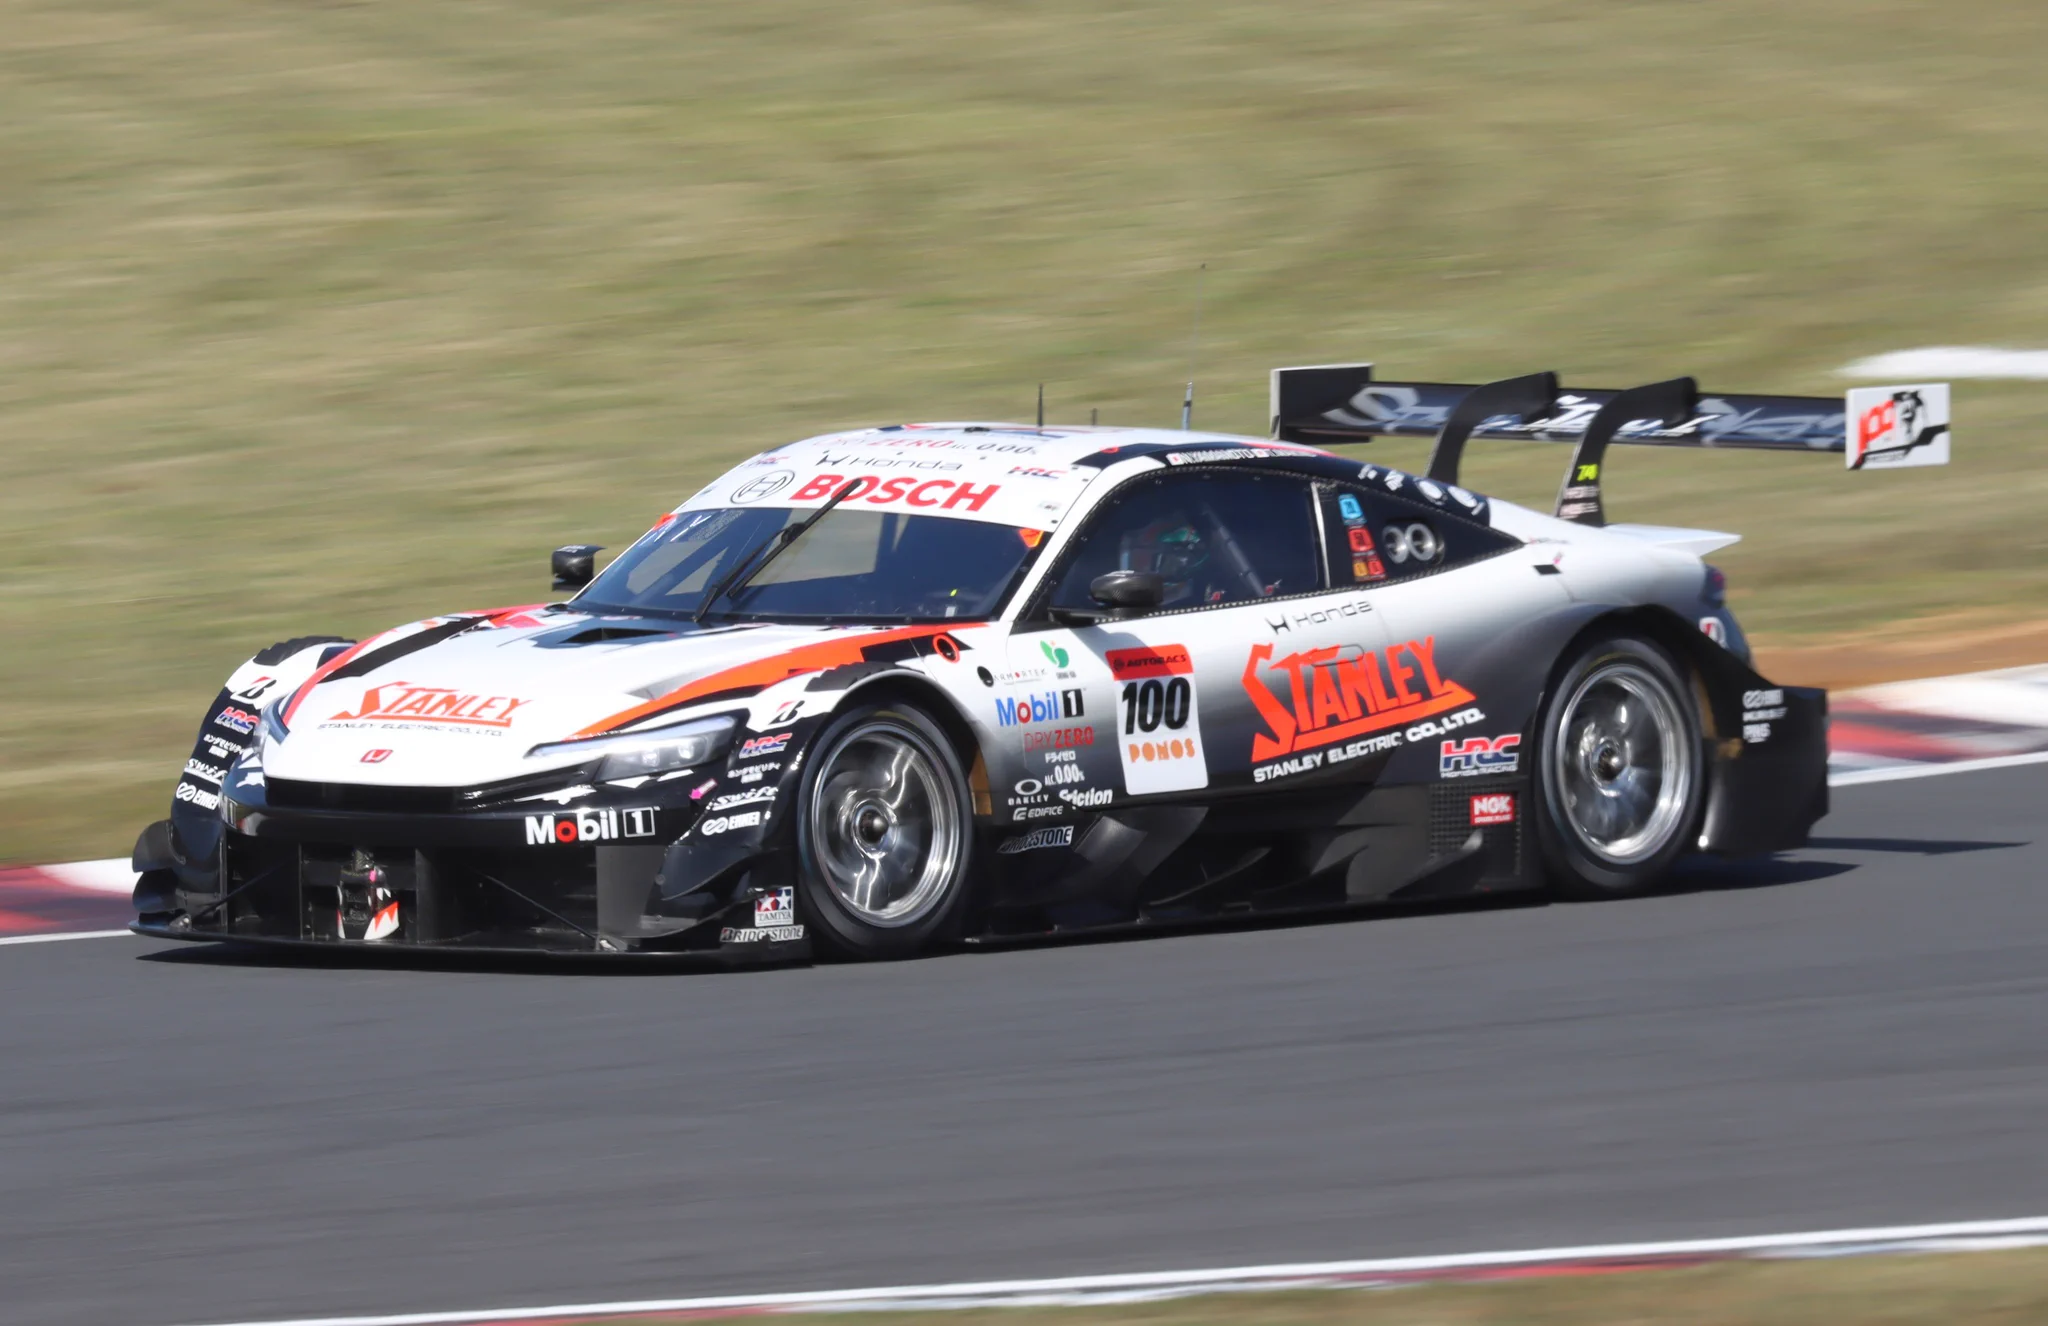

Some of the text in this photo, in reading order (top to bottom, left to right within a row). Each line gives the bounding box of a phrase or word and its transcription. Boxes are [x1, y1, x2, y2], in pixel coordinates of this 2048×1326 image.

[849, 457, 963, 471] Honda
[1007, 465, 1068, 480] HRC
[789, 474, 1002, 513] BOSCH
[1295, 600, 1372, 626] Honda
[1127, 654, 1186, 668] AUTOBACS
[327, 680, 532, 729] STANLEY
[995, 691, 1059, 727] Mobil
[1121, 676, 1191, 735] 100
[1242, 635, 1477, 763] STANLEY
[739, 732, 793, 758] HRC
[1128, 737, 1196, 764] PONOS
[1252, 751, 1323, 783] STANLEY
[1327, 731, 1403, 765] ELECTRIC
[1440, 733, 1521, 772] HRC
[1007, 794, 1050, 806] OAKLEY
[1027, 804, 1064, 819] EDIFICE
[1473, 795, 1513, 816] NGK
[525, 808, 619, 845] Mobil
[757, 911, 793, 922] TAMIYA
